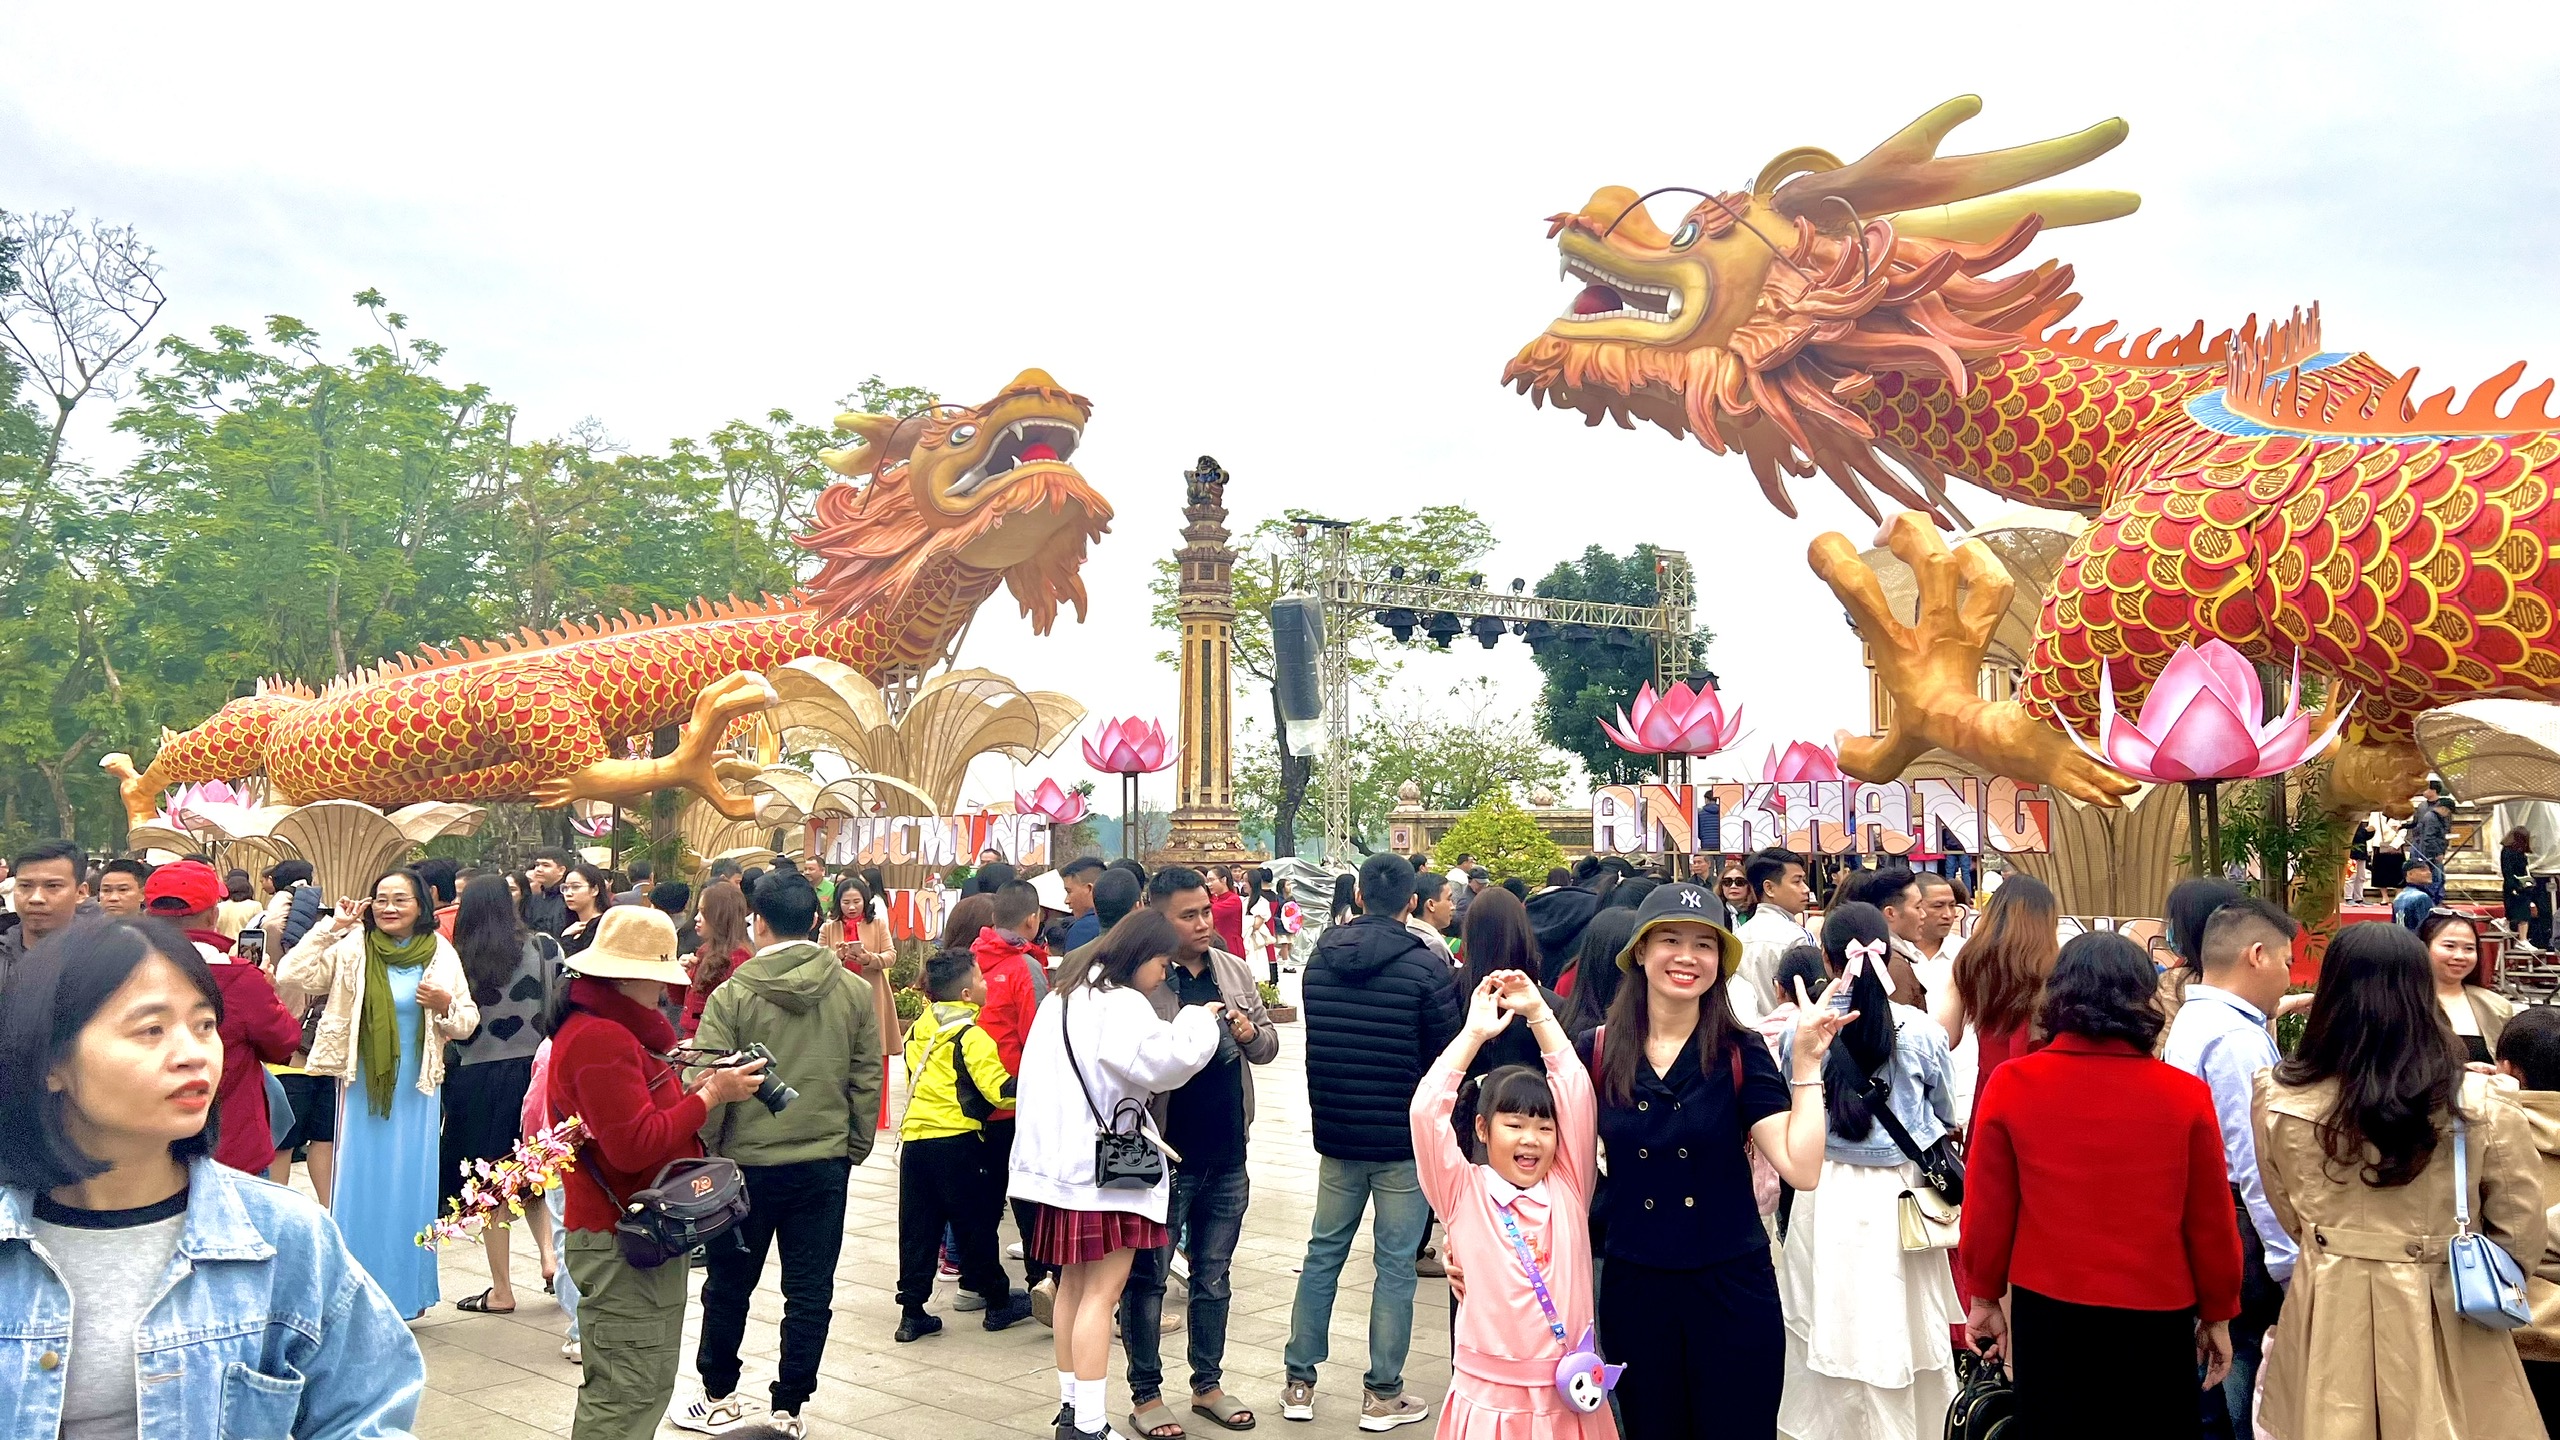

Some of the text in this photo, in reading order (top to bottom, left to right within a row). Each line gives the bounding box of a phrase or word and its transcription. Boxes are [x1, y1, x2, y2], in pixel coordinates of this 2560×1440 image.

[804, 801, 917, 865] CHÚC
[1592, 776, 2052, 854] AN KHANG
[1680, 889, 1702, 908] NY
